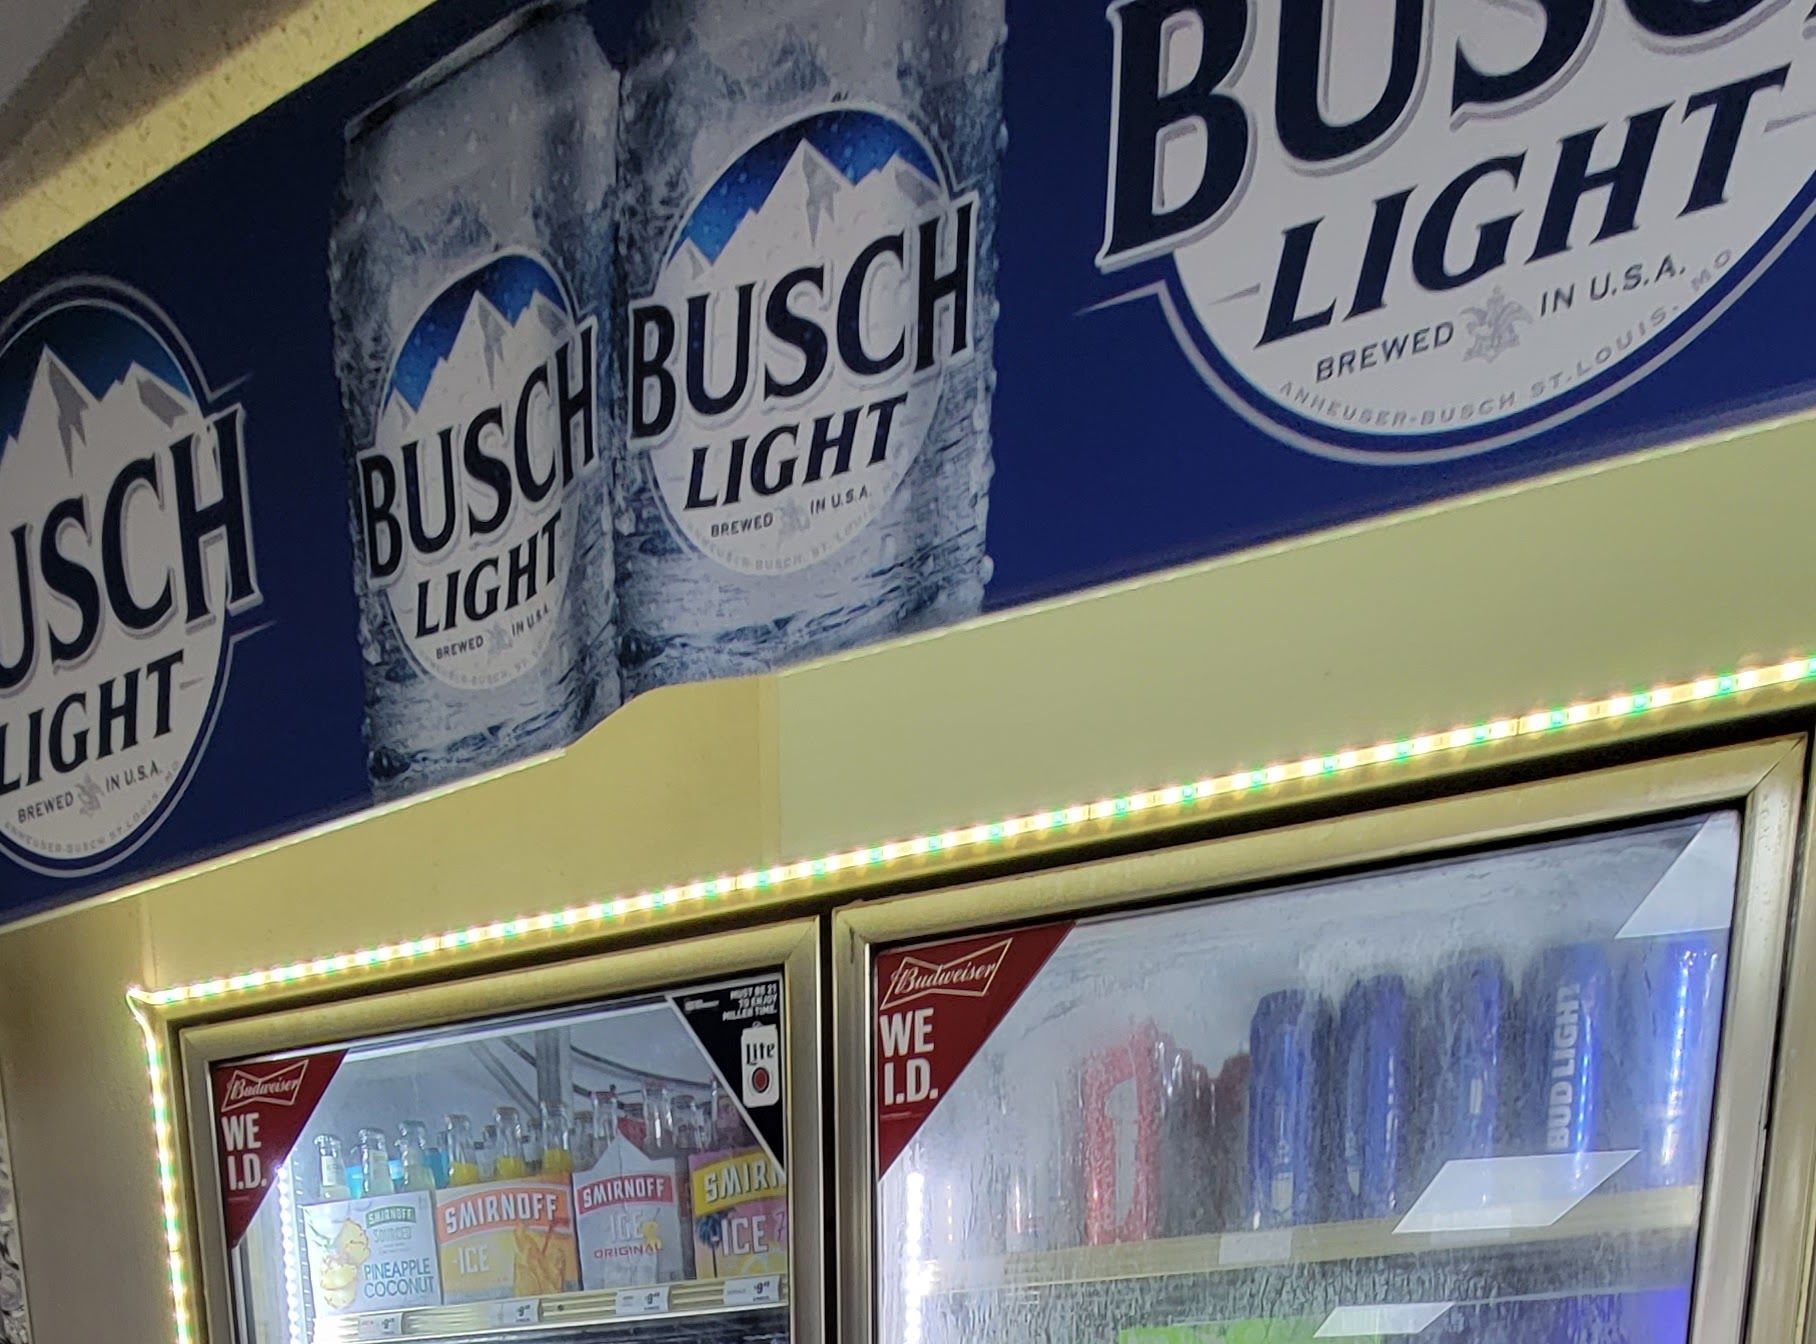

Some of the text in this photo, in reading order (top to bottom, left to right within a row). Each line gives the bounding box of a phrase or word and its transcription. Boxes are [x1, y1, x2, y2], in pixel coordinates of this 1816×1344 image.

[1254, 62, 1792, 349] LIGHT
[631, 200, 974, 440] BUSCH
[1316, 254, 1686, 382] BREWED IN U.S.A.
[1279, 381, 1517, 427] ANHEUSER-BUSCH
[361, 327, 596, 579] BUSCH
[683, 391, 907, 512] LIGHT
[710, 512, 774, 538] BREWED
[810, 499, 826, 515] IN
[415, 509, 562, 639] LIGHT
[436, 635, 484, 660] BREWED
[511, 621, 525, 636] IN
[0, 649, 184, 796] LIGHT
[18, 792, 74, 823] BREWED
[105, 774, 121, 792] IN
[730, 987, 754, 1000] MUST
[767, 983, 777, 995] 21
[890, 960, 998, 994] Budweiser
[722, 1007, 754, 1021] MILLER
[879, 1008, 935, 1057] WE
[746, 1042, 775, 1066] Lite
[1547, 982, 1581, 1150] BUD LIGHT
[230, 1077, 300, 1101] Budweiser
[884, 1058, 939, 1105] I.D.
[221, 1113, 262, 1151] WE
[227, 1153, 268, 1191] I.D.
[444, 1191, 558, 1234] SMIRNOFF
[583, 1177, 666, 1209] SMIRNOFF
[593, 1242, 664, 1259] ORIGINAL
[721, 1215, 768, 1256] ICE
[364, 1257, 431, 1280] PINEAPPLE
[457, 1244, 490, 1275] ICE
[364, 1276, 434, 1298] COCONUT
